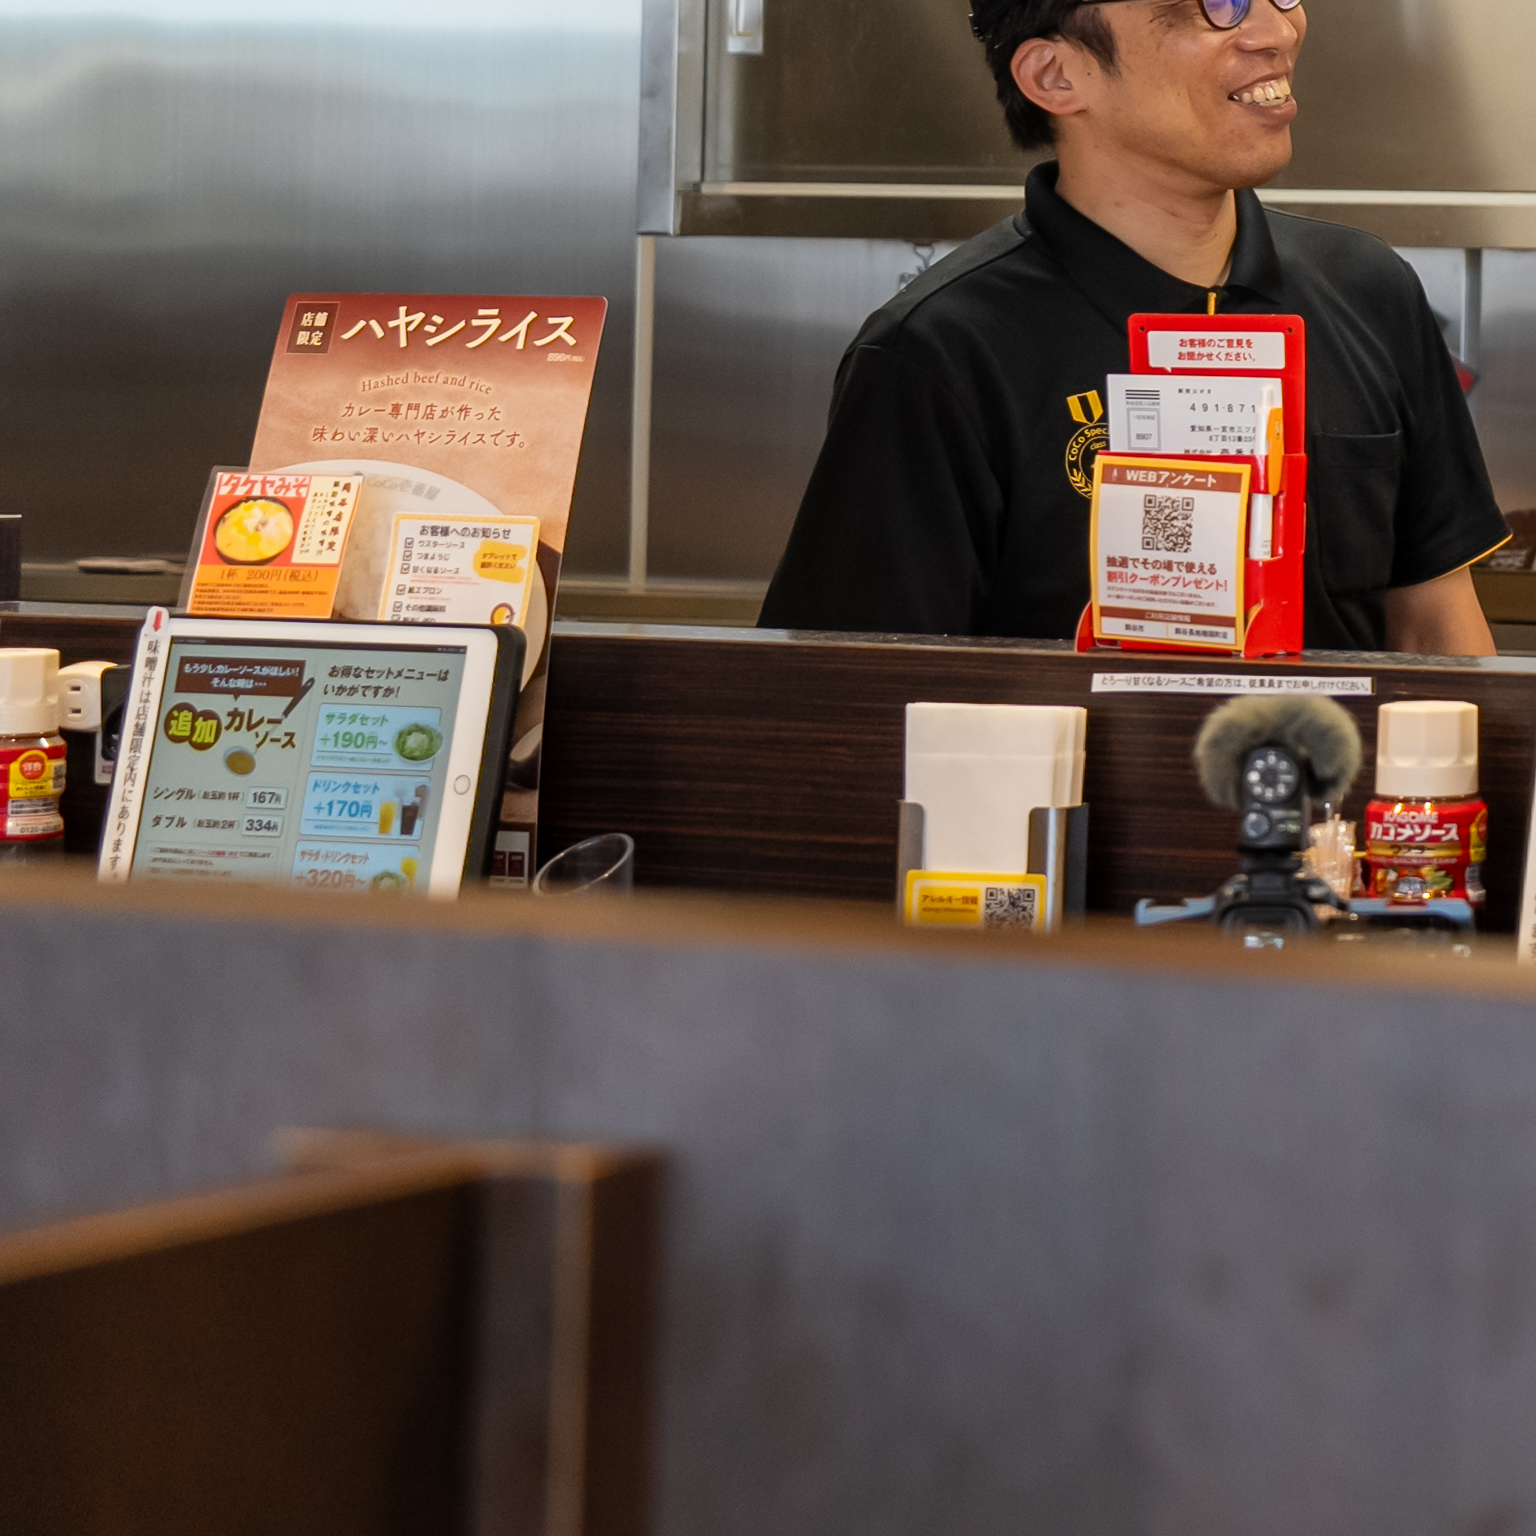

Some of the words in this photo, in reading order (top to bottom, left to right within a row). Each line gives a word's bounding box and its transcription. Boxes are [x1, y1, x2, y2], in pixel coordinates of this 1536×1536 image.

[300, 311, 329, 327] 店舗
[340, 305, 578, 349] ハヤシライス
[296, 330, 323, 346] 限定
[1178, 337, 1254, 350] お客様のご意見を
[1177, 350, 1256, 362] お聞かせください。
[361, 371, 409, 393] Hashed
[413, 370, 441, 385] beef
[442, 373, 466, 387] and
[467, 376, 493, 395] rice
[341, 403, 501, 422] カレー専門店が作った
[1190, 403, 1256, 413] 491-871
[312, 427, 526, 449] 味わい深いハヤシライスです。
[222, 474, 309, 496] タケヤみそ
[1126, 468, 1217, 486] WEBアンケート
[419, 525, 512, 540] お客様へのお知らせ
[418, 540, 466, 549] ウスターソース
[416, 552, 451, 561] つまようじ
[412, 565, 460, 575] 甘くなるソース
[1106, 555, 1217, 575] 抽選でその場で使える
[183, 664, 300, 677] もう少しカレーソースがほしい!
[328, 665, 449, 682] お得なセットメニューは
[323, 684, 401, 698] いかがですか!
[325, 712, 389, 726] サラダセット
[168, 710, 217, 744] 追加
[224, 707, 283, 733] カレー
[255, 731, 297, 749] ソース
[312, 779, 380, 795] ドリンクセット
[153, 787, 196, 801] シングル
[251, 791, 282, 805] 167円
[313, 799, 372, 818] +170円
[152, 815, 187, 828] ダブル
[245, 818, 279, 832] 334円
[1370, 822, 1459, 841] カゴメソース
